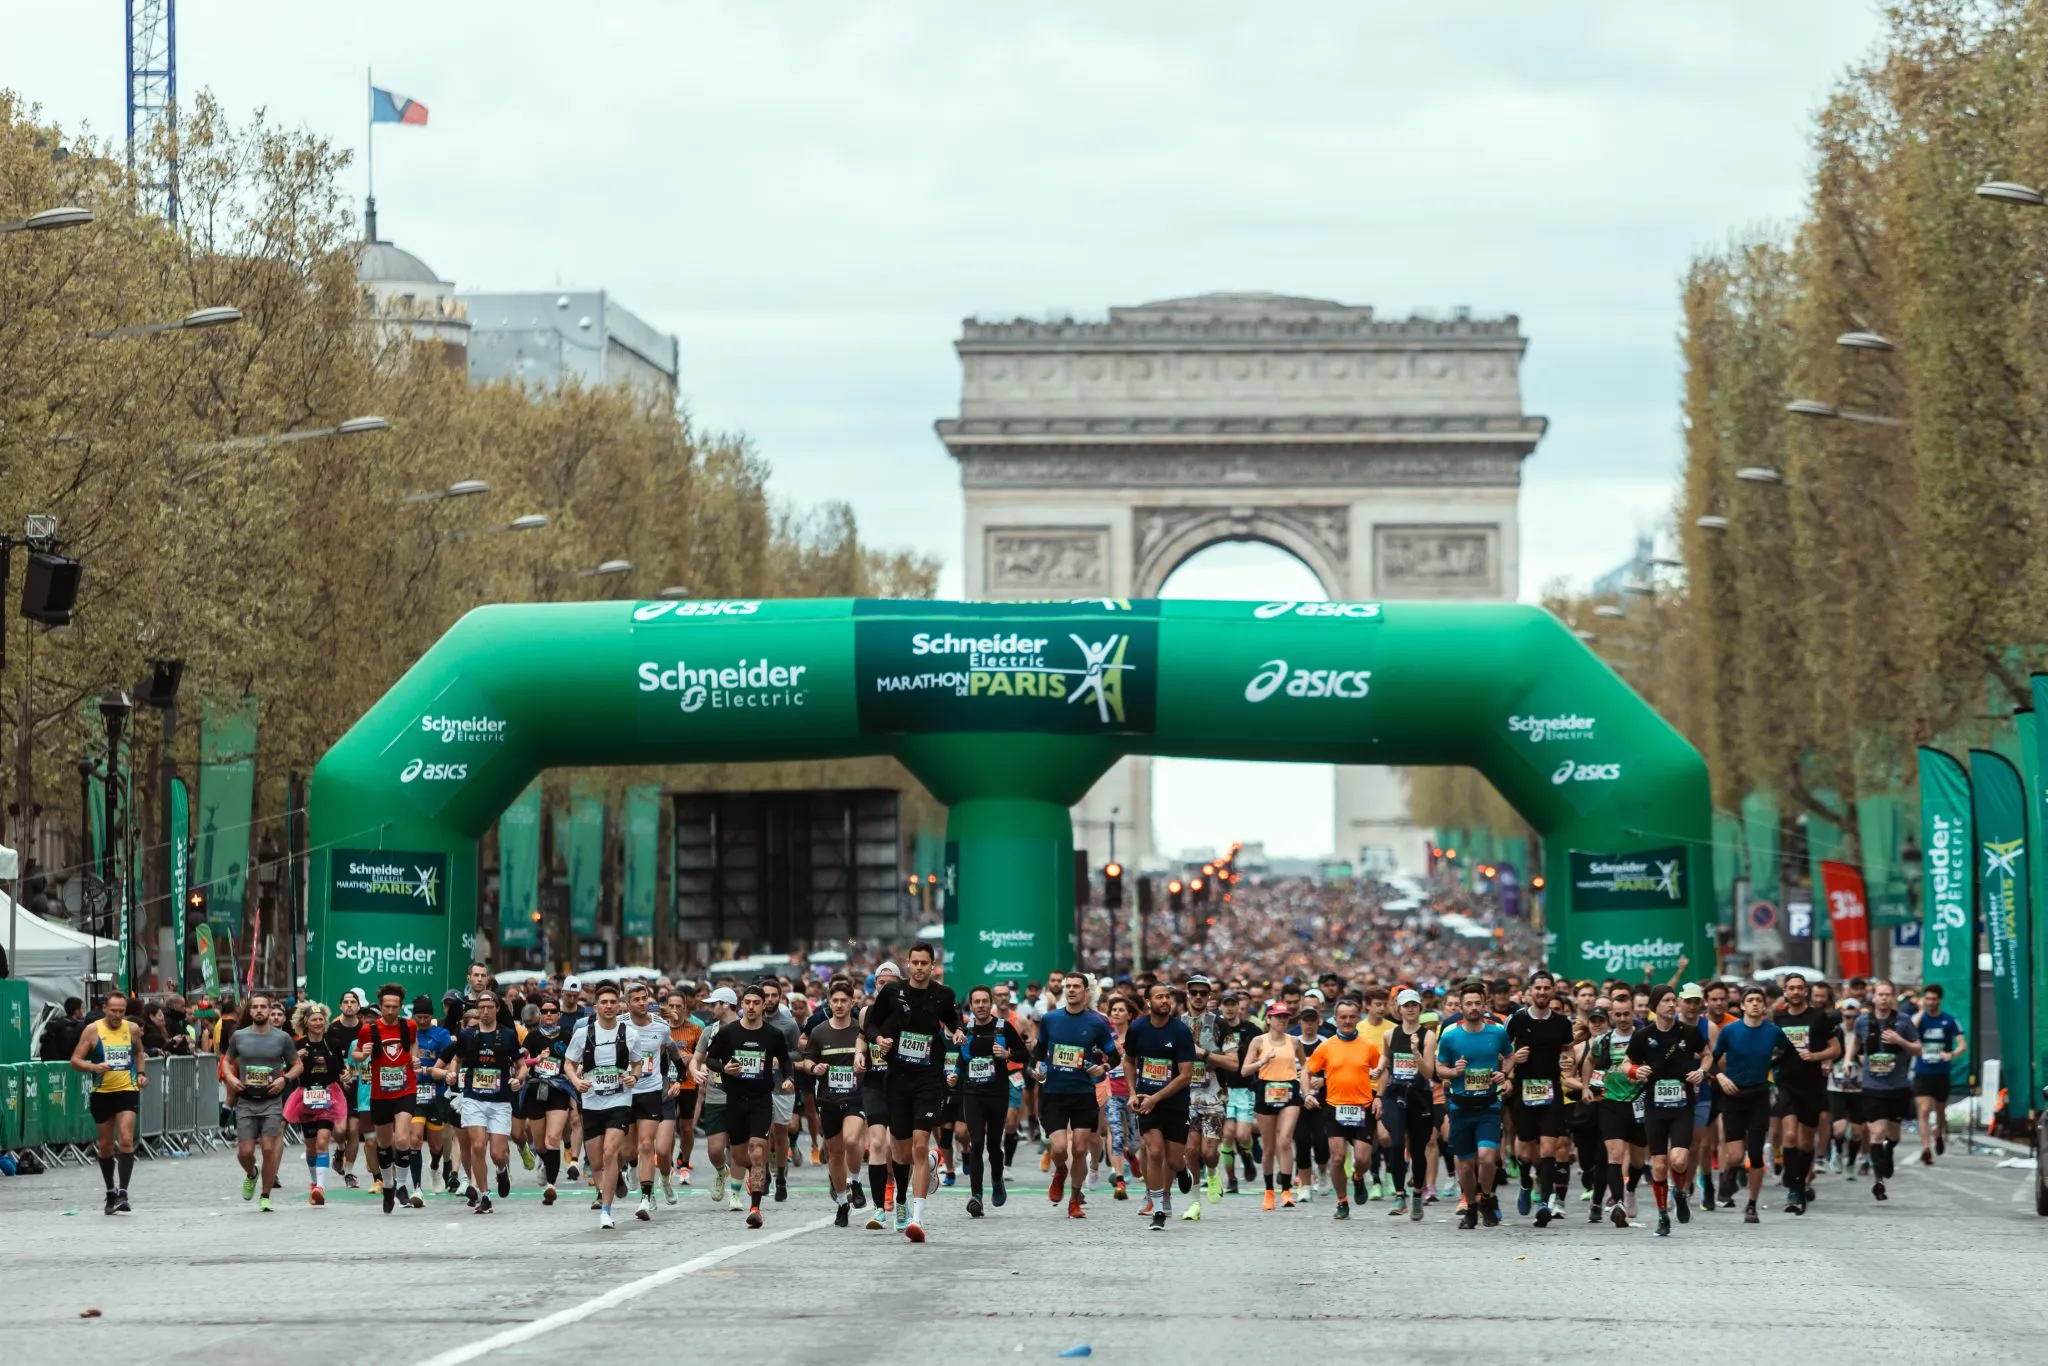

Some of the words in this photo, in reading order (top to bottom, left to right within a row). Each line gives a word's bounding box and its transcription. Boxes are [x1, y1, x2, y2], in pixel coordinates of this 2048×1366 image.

[675, 600, 763, 616] asics
[1295, 602, 1380, 617] asics
[912, 632, 1048, 655] Schneider
[970, 654, 1044, 667] Electric
[638, 658, 806, 691] Schneider
[877, 671, 969, 692] MARATHON
[956, 686, 969, 696] DE
[970, 672, 1066, 697] PARIS
[1286, 669, 1371, 698] asics
[711, 689, 803, 708] Electric
[422, 715, 507, 732] Schneider
[1508, 712, 1596, 731] Schneider
[457, 731, 505, 741] Electric
[422, 763, 467, 780] asics
[1573, 763, 1621, 781] asics
[1950, 816, 1964, 901] Electric
[349, 862, 405, 876] Schneider
[1589, 862, 1648, 874] Schneider
[336, 880, 372, 889] MARATHON
[372, 881, 413, 895] PARIS
[1929, 815, 1950, 968] Schneider
[2003, 879, 2017, 938] PARIS
[979, 930, 1035, 942] Schneider
[1988, 891, 2005, 976] Schneider
[335, 940, 437, 962] Schneider
[1581, 938, 1684, 960] Schneider
[377, 961, 434, 975] Electric
[997, 961, 1024, 972] asics
[901, 1039, 925, 1052] 42476
[1058, 1051, 1074, 1061] 4110
[475, 1073, 494, 1083] 34417
[595, 1074, 618, 1085] 34301
[1657, 1086, 1680, 1096] 33617
